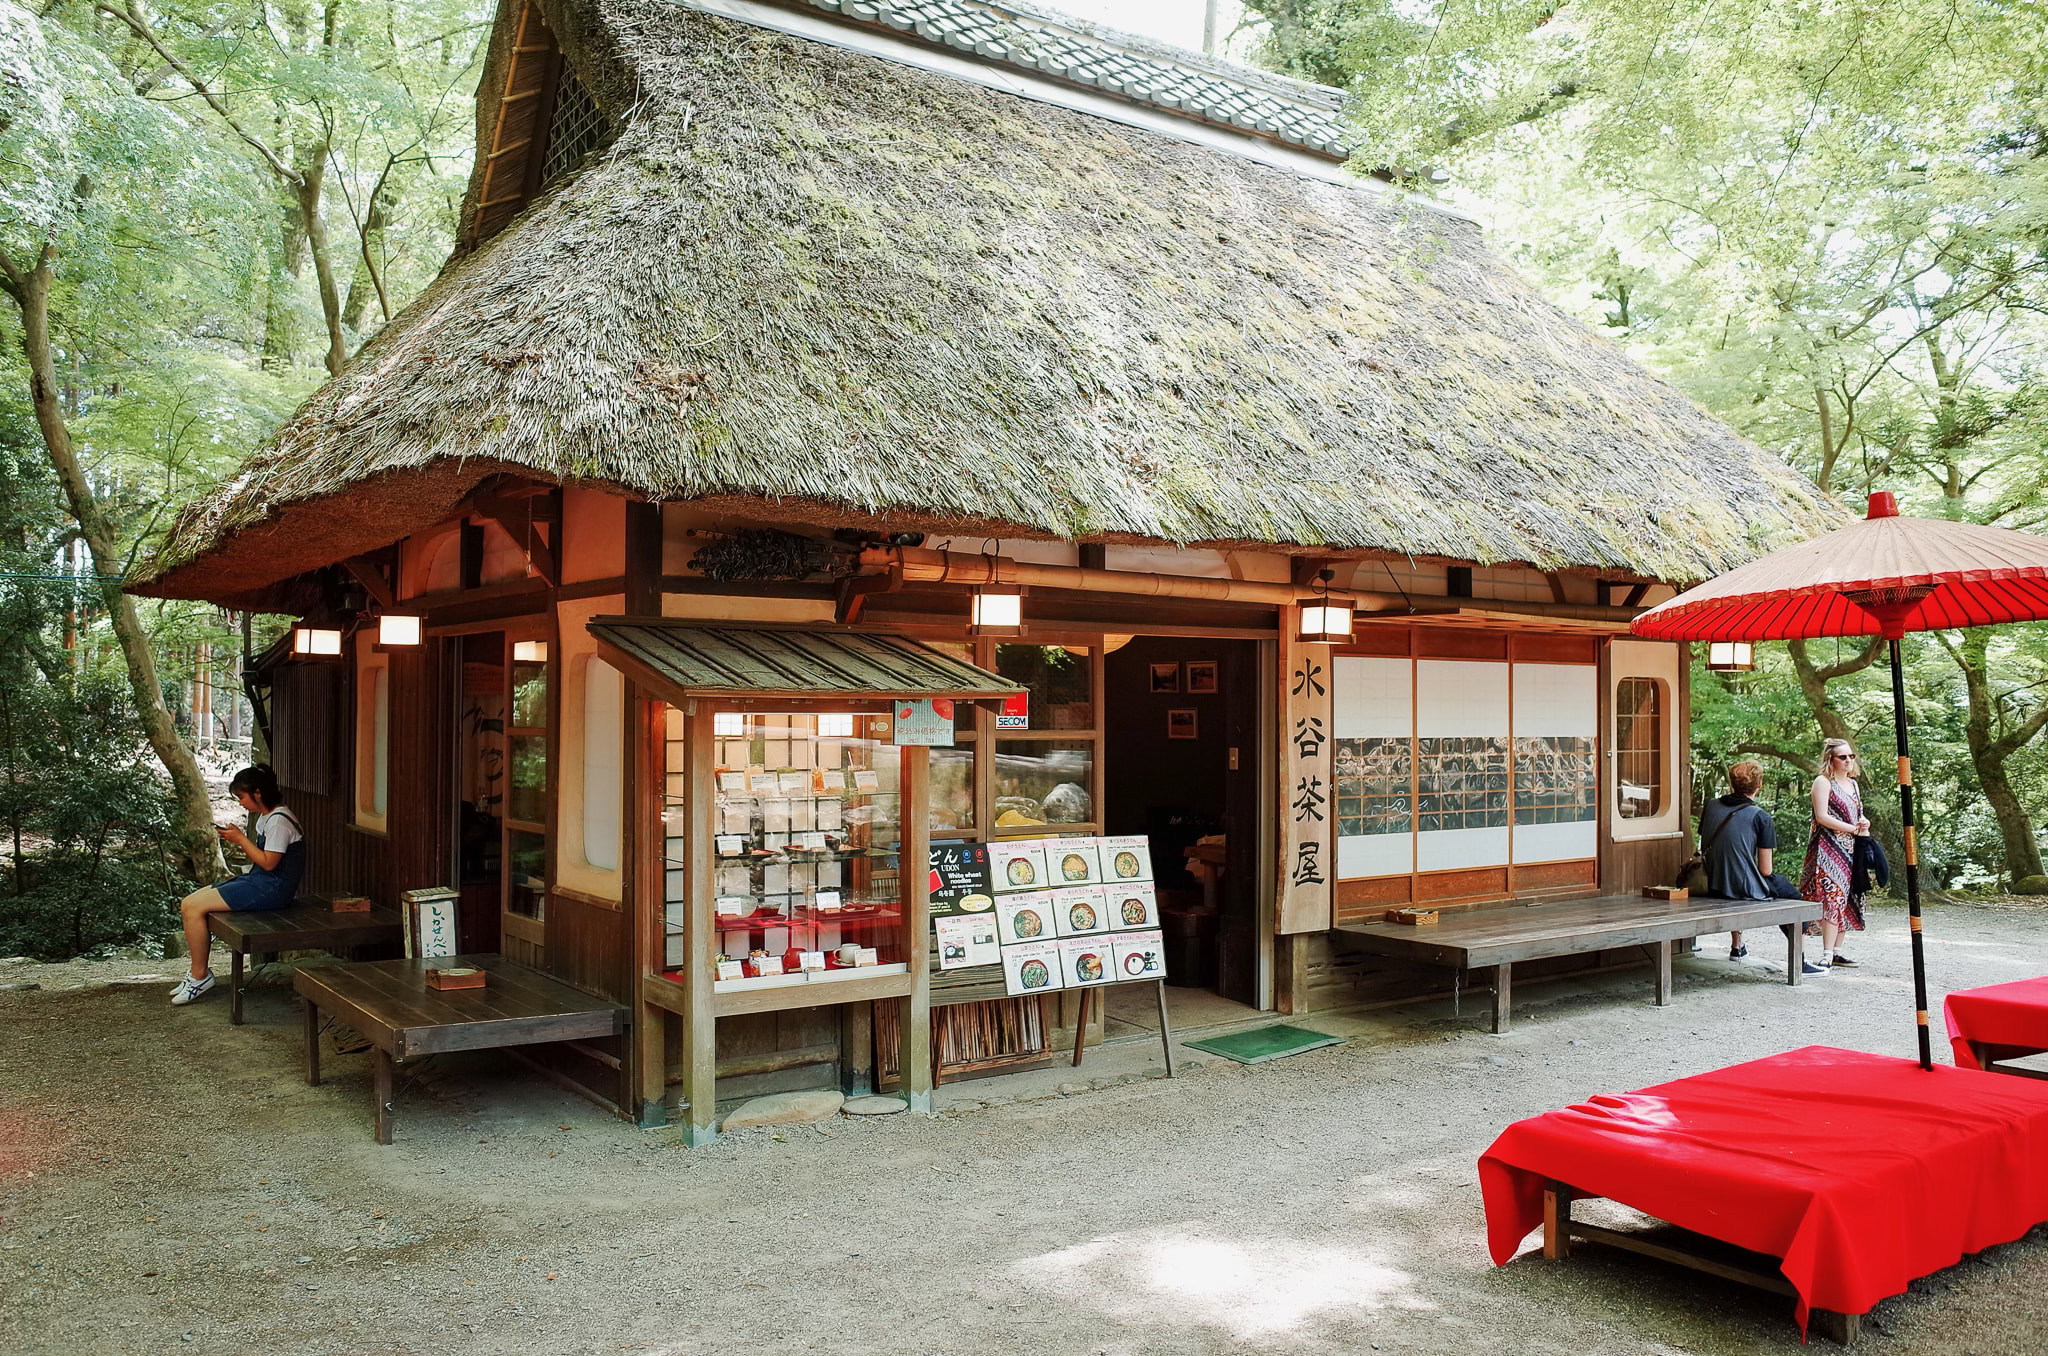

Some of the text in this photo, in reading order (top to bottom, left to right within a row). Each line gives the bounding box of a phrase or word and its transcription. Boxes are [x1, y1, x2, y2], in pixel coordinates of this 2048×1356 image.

[998, 717, 1026, 726] SECOM
[1292, 657, 1326, 888] 水谷茶屋
[432, 906, 447, 959] しかせんべい
